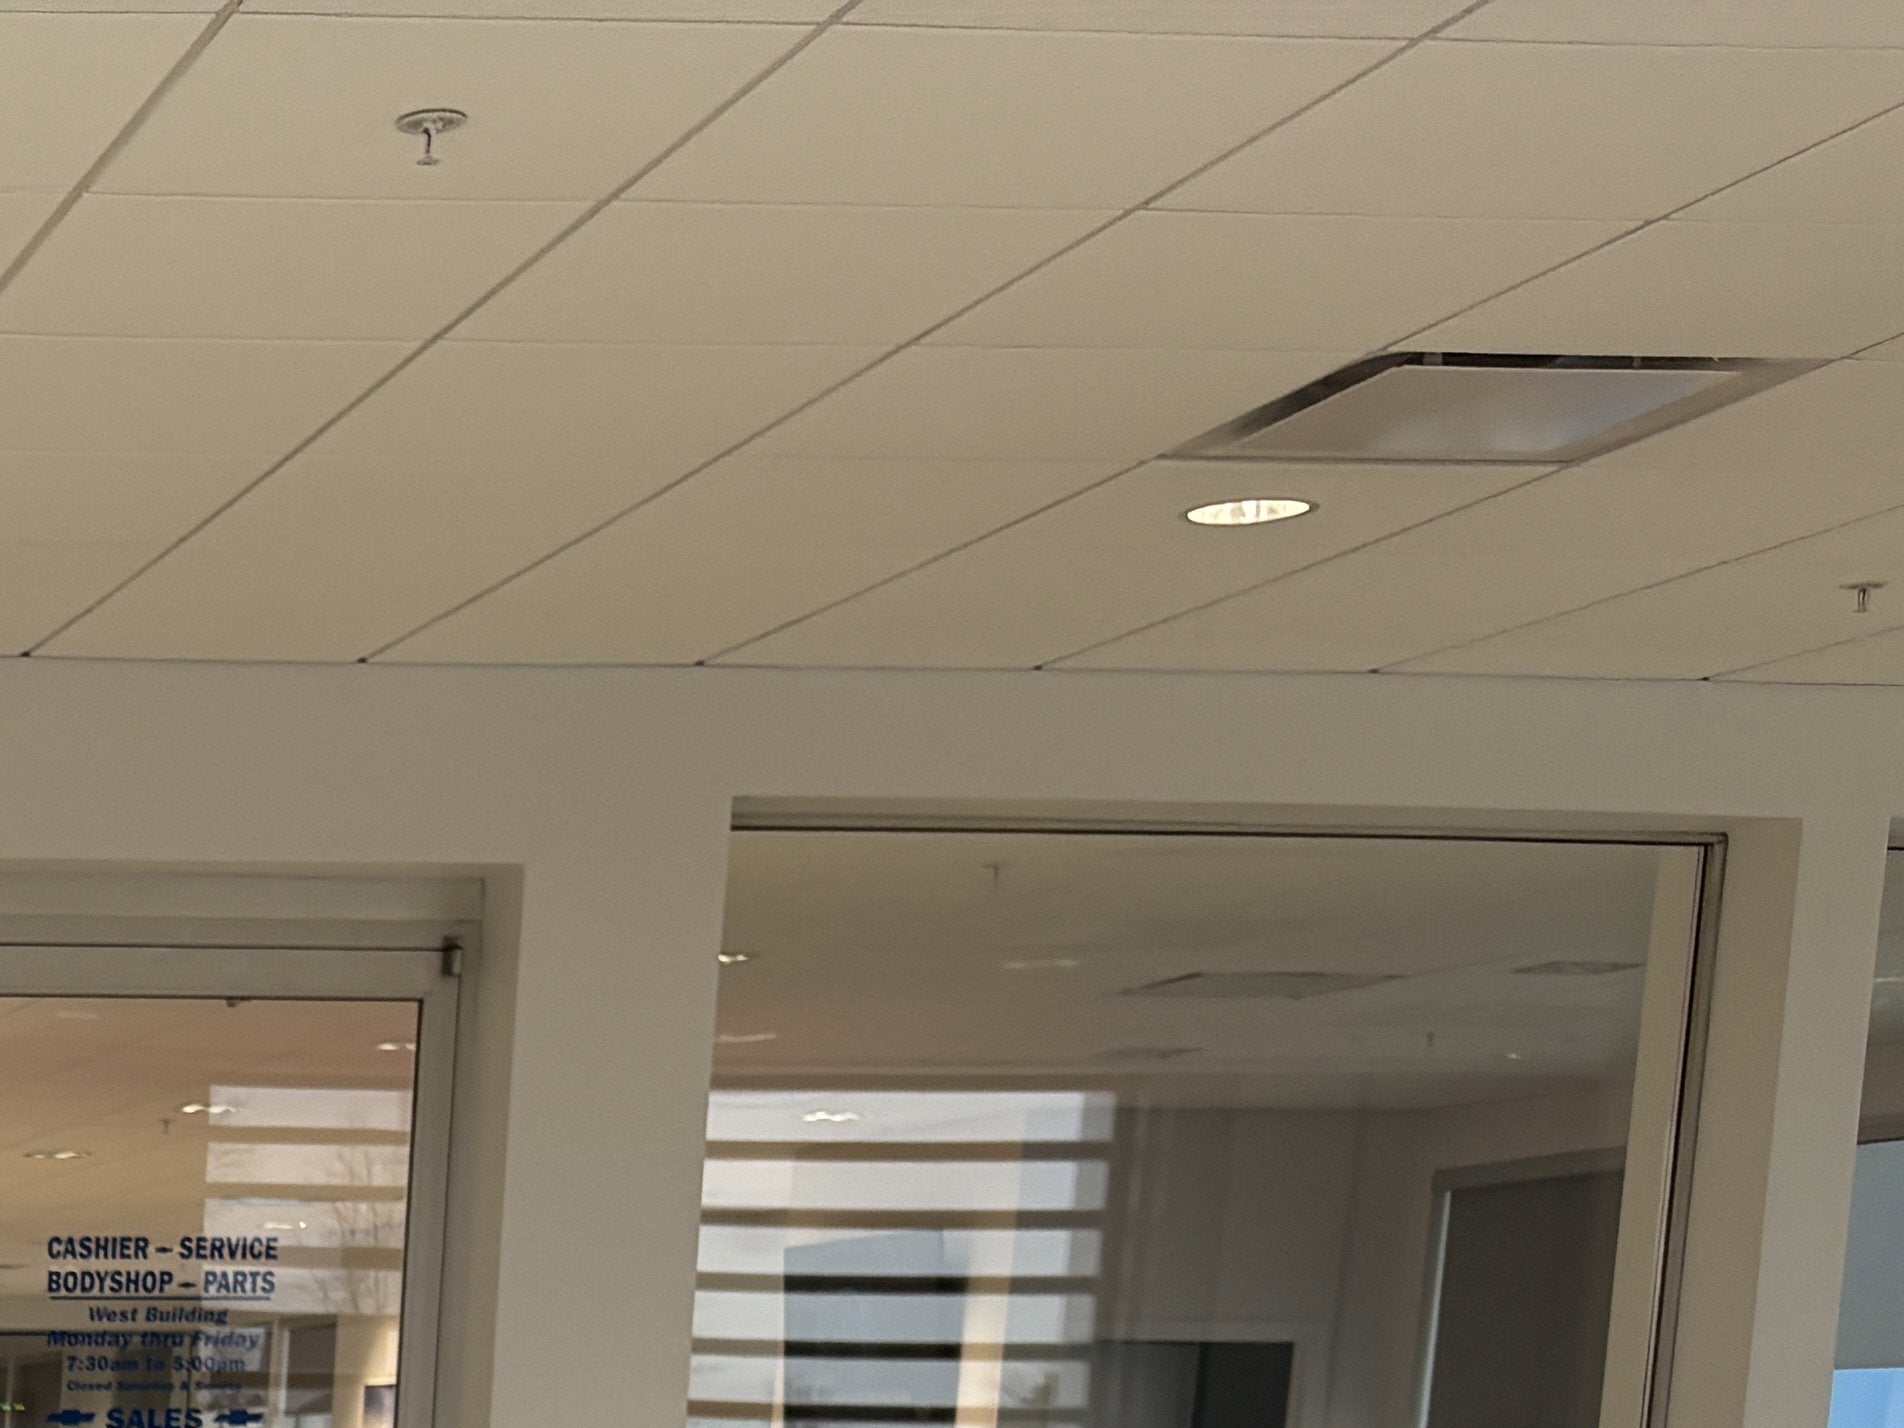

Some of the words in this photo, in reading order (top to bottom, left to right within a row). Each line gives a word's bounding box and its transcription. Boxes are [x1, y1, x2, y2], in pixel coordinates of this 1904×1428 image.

[47, 1236, 150, 1260] CASHIER
[179, 1237, 279, 1260] SERVICE
[47, 1270, 174, 1294] BODYSHOP
[204, 1271, 276, 1294] PARTS
[89, 1307, 138, 1323] West
[145, 1307, 228, 1326] Building
[47, 1331, 132, 1349] Monday
[191, 1332, 260, 1349] Friday
